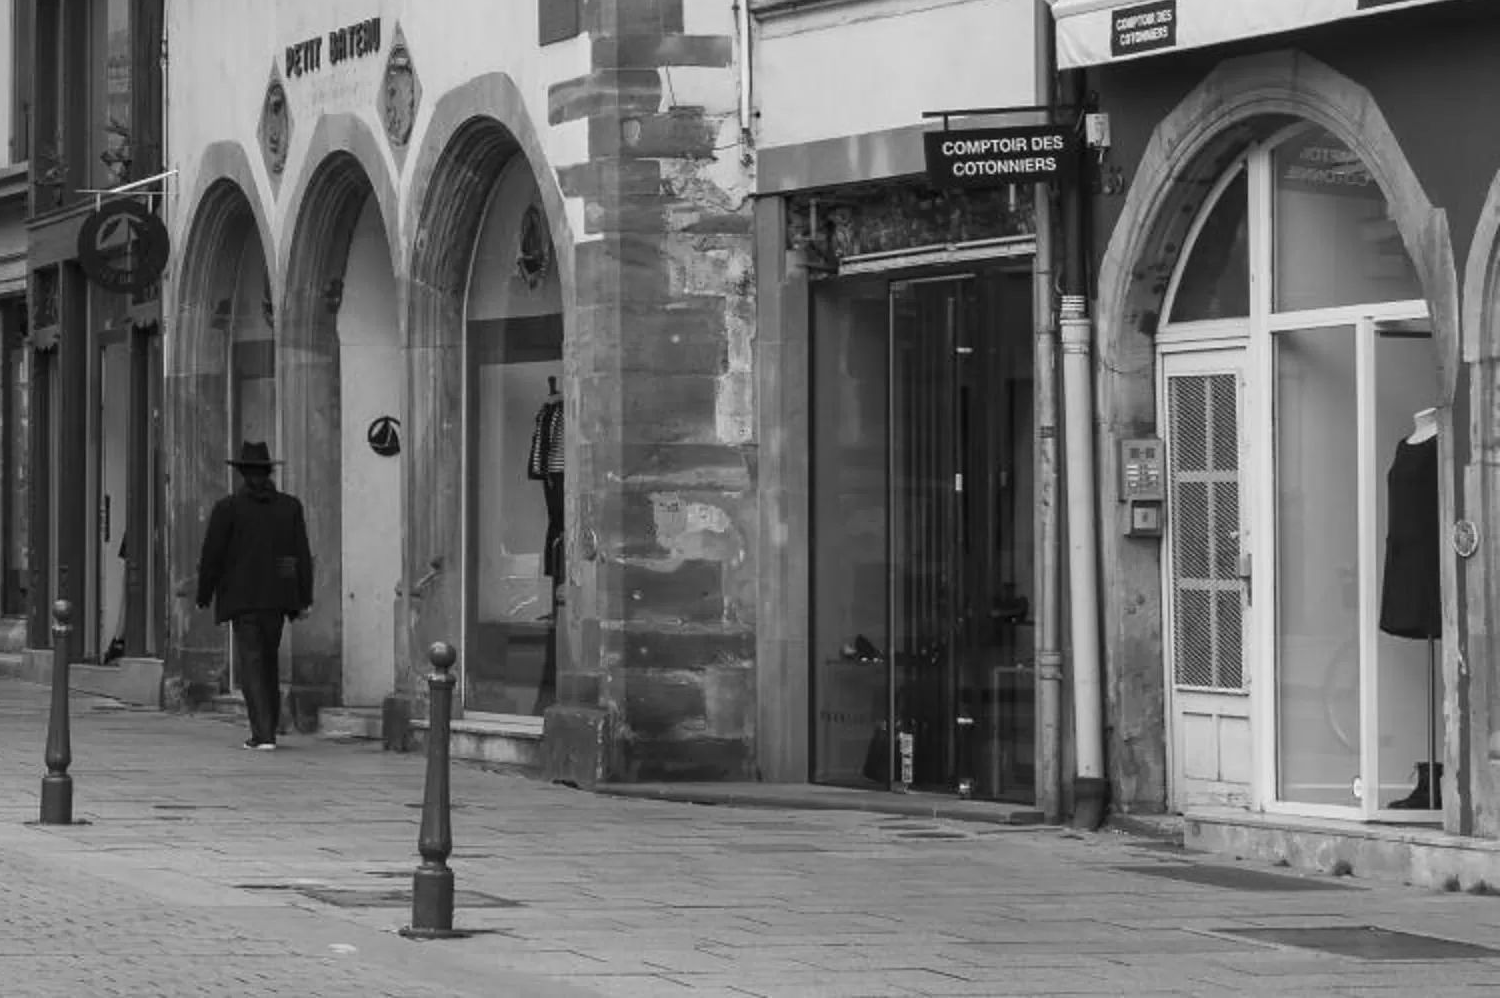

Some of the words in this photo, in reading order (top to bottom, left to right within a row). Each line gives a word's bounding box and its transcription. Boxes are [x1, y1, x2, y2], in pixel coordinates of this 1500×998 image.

[1116, 12, 1155, 31] COMPTOIR
[1156, 8, 1173, 23] DES
[1120, 25, 1169, 46] COTONNIERS
[285, 36, 322, 79] PETIT
[329, 16, 381, 67] BATEAU
[942, 136, 1027, 155] COMPTOIR
[1031, 134, 1064, 151] DES
[953, 156, 1057, 176] COTONNIERS
